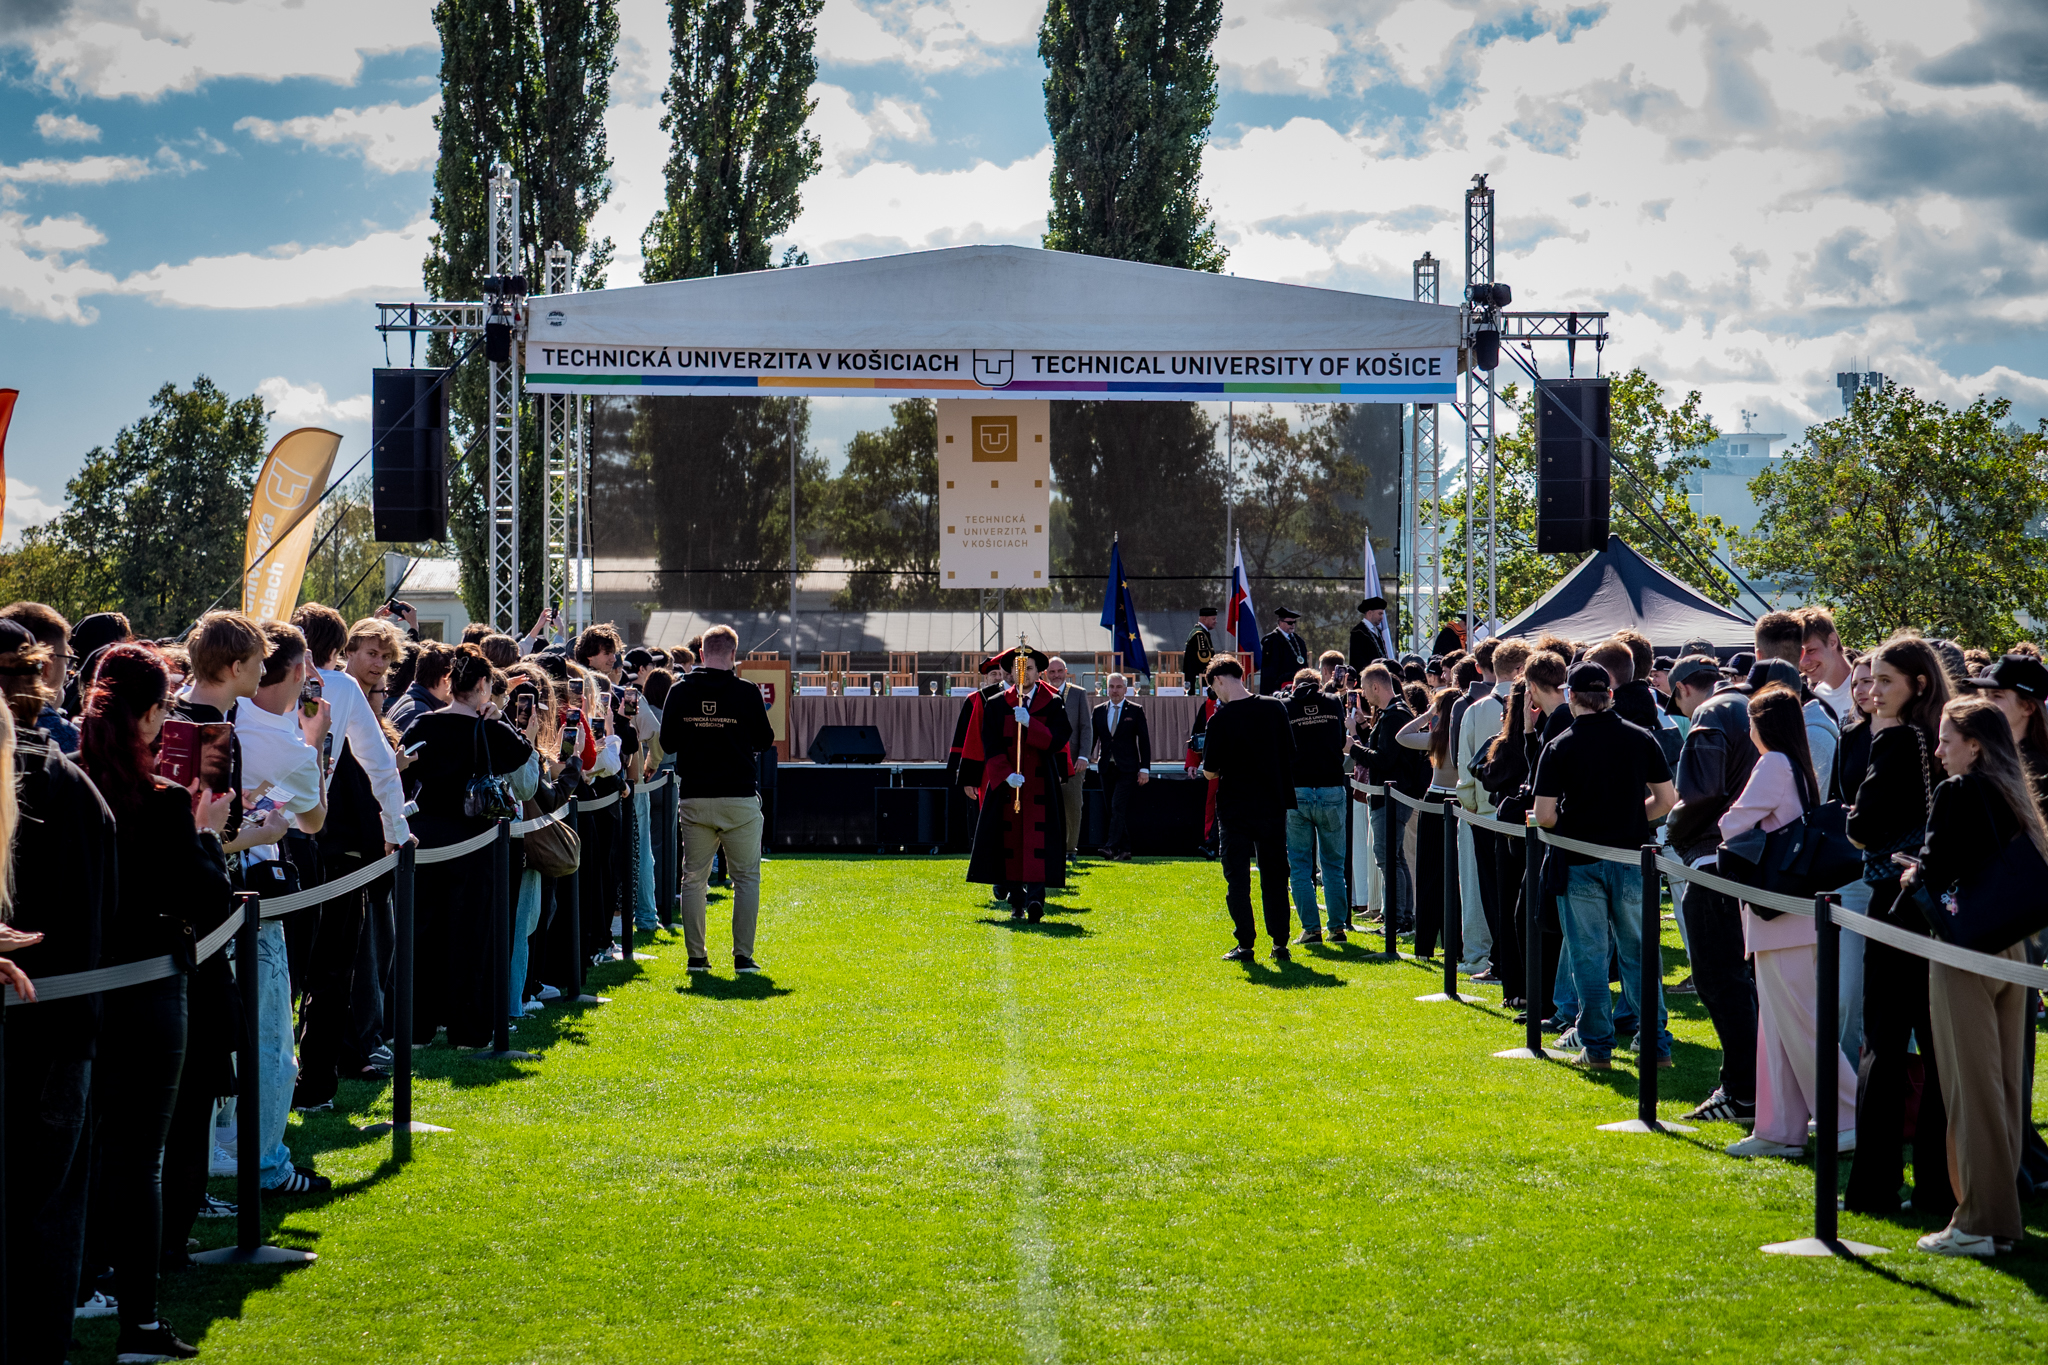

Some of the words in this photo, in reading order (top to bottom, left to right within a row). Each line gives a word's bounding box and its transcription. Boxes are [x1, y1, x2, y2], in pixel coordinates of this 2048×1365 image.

[541, 346, 672, 368] TECHNICKÁ
[677, 350, 812, 370] UNIVERZITA
[816, 352, 832, 370] V
[837, 349, 959, 372] KOŠICIACH
[1031, 355, 1166, 375] TECHNICAL
[1171, 356, 1314, 376] UNIVERSITY
[1319, 356, 1349, 376] OF
[1356, 352, 1441, 377] KOŠICE
[965, 514, 1026, 524] TECHNICKÁ
[963, 527, 1027, 536] UNIVERZITA
[962, 540, 969, 548] V
[971, 538, 1028, 548] KOŠICIACH
